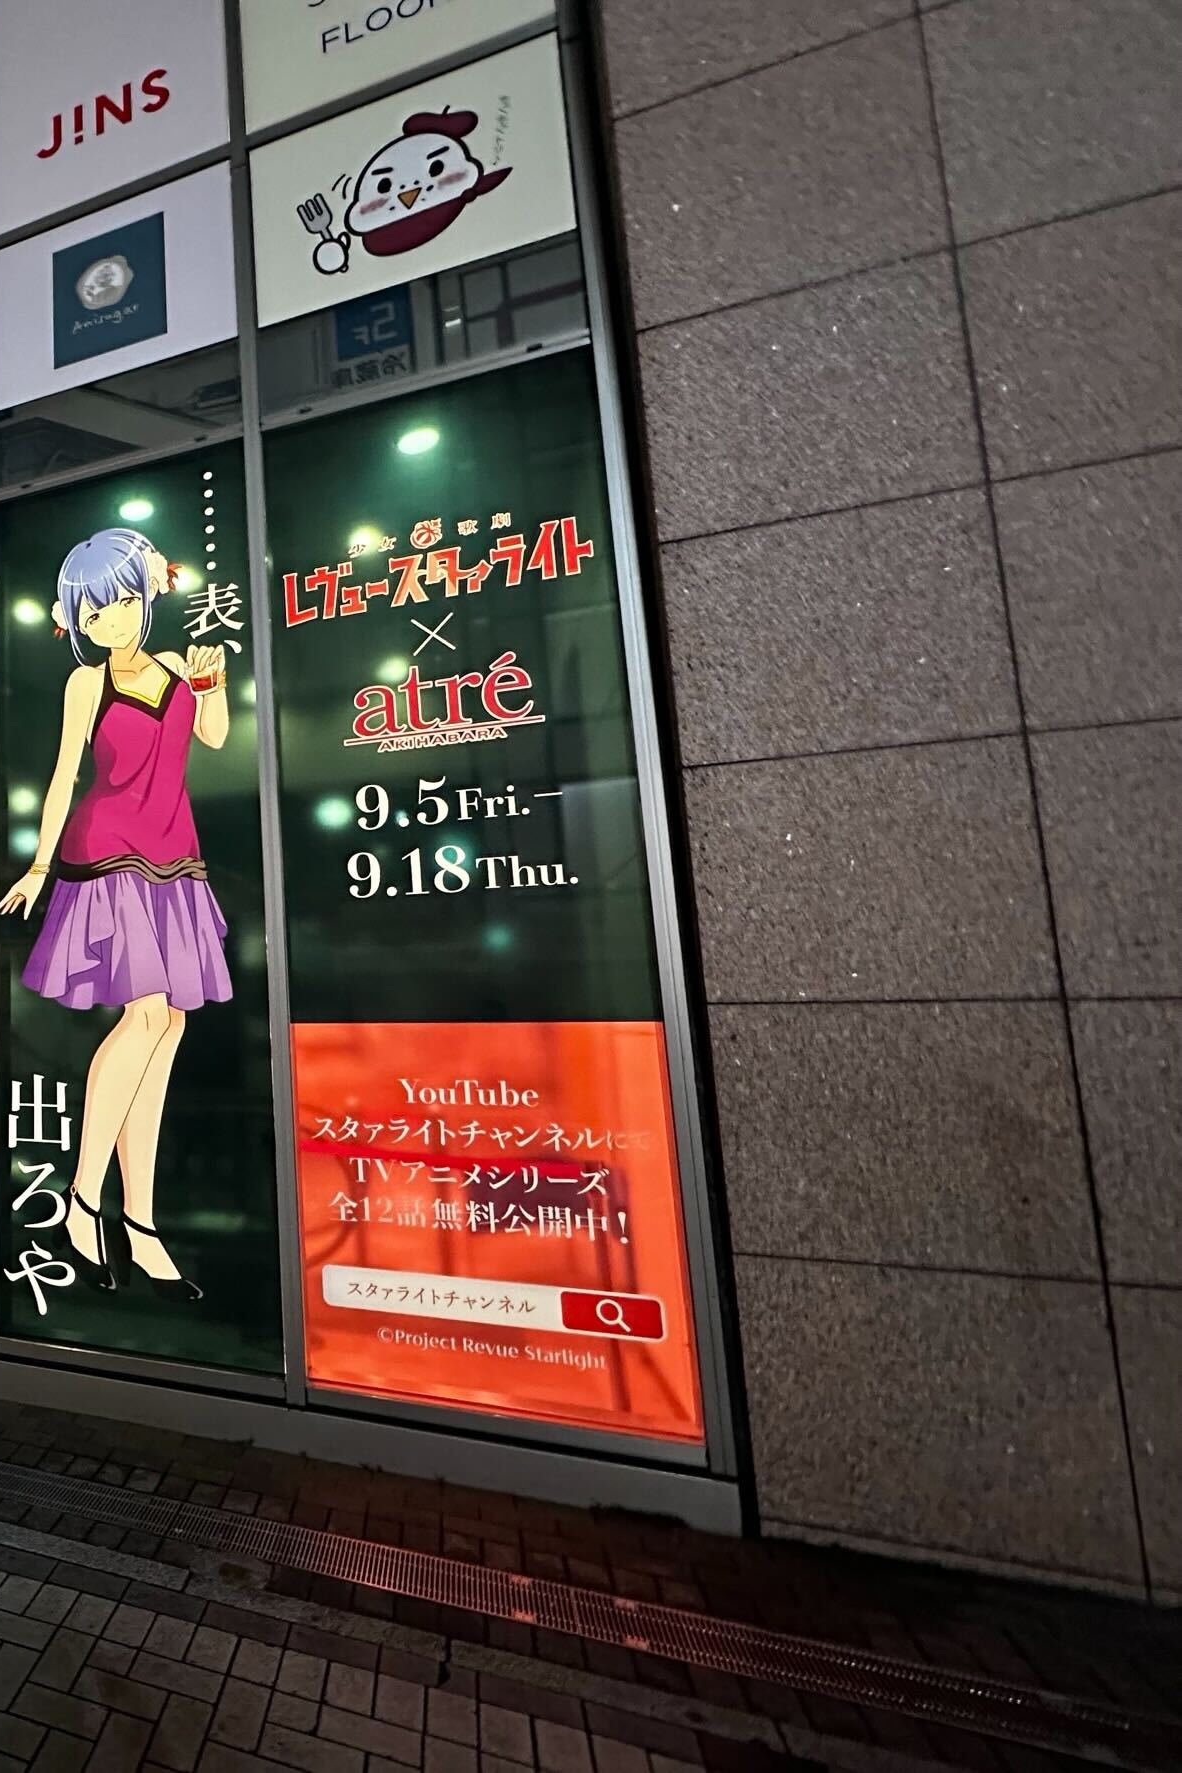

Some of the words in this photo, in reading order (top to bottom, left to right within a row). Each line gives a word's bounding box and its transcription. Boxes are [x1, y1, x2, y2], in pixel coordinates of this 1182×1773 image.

[322, 0, 435, 53] FLOO
[282, 516, 595, 628] レヴュースタァライト
[352, 650, 537, 741] atré
[376, 727, 508, 753] AKIHABARA
[398, 1077, 540, 1108] YouTube
[3, 1073, 76, 1316] 出ろや
[346, 1279, 536, 1315] スタァライトチャンネル
[462, 1336, 519, 1360] Revue
[524, 1345, 609, 1371] Starlight
